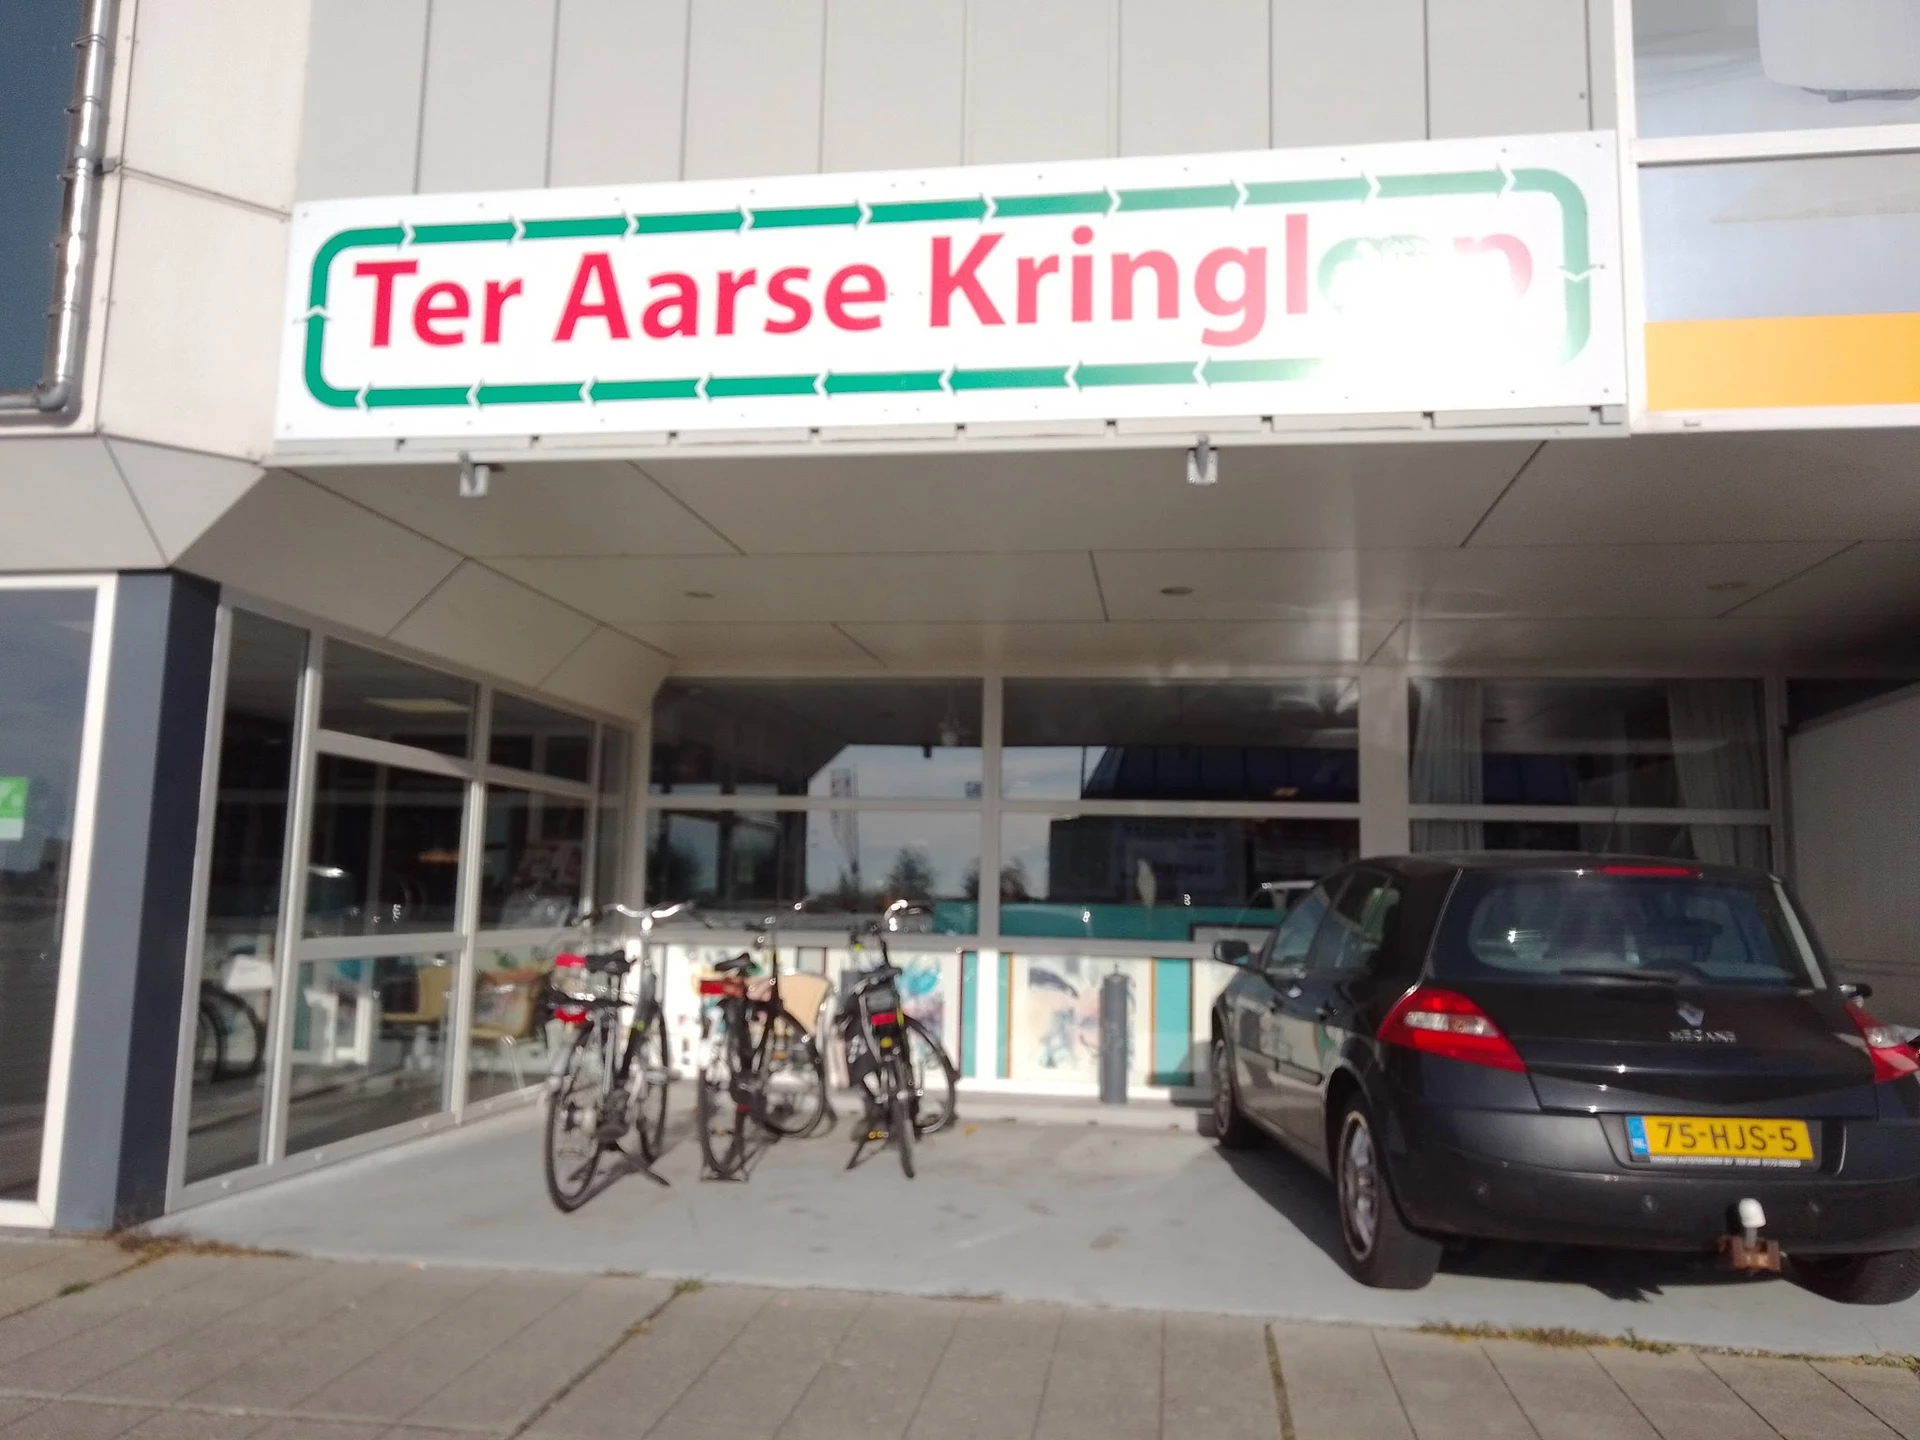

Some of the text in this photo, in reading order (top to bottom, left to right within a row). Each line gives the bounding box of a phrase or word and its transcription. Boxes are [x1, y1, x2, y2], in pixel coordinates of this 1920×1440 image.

[353, 213, 1534, 348] Ter Aarse Kringl
[1657, 1122, 1798, 1152] 75-HJS-5
